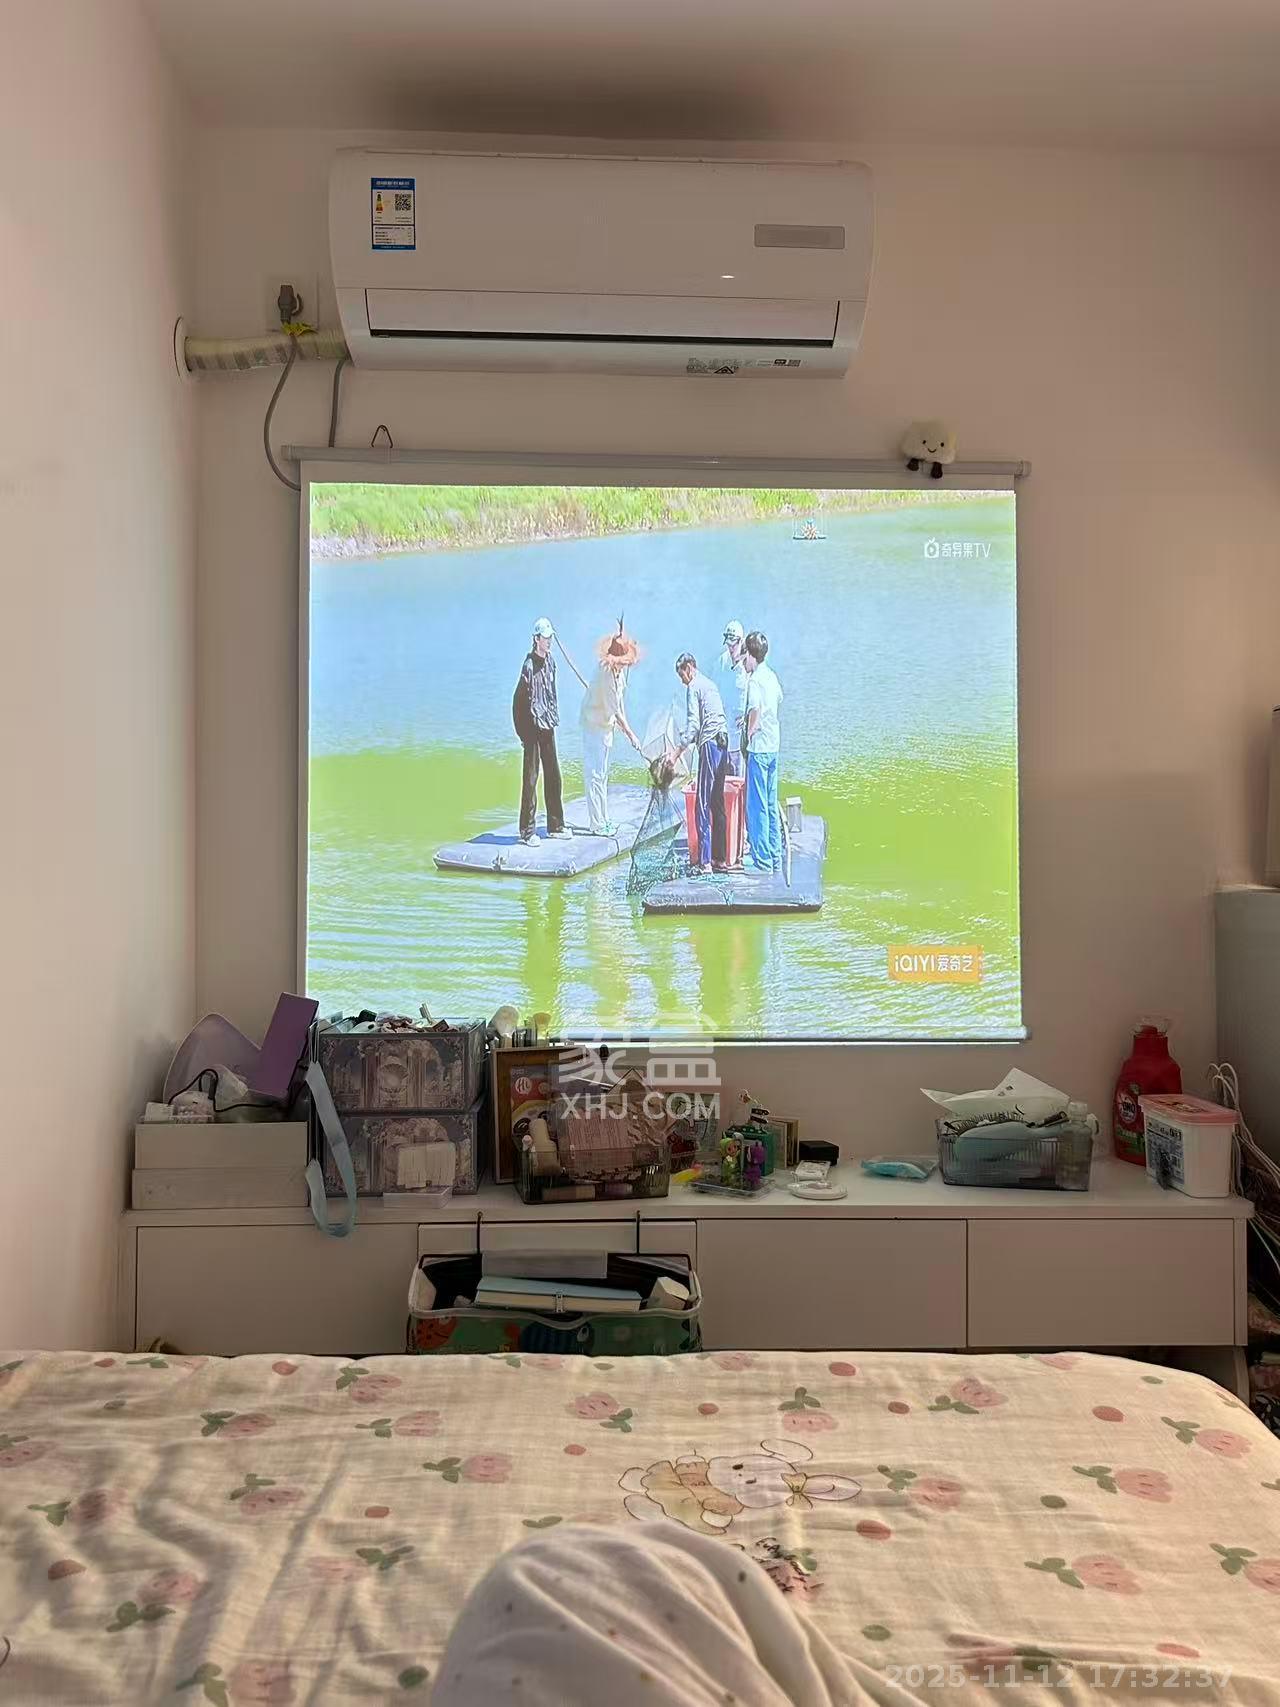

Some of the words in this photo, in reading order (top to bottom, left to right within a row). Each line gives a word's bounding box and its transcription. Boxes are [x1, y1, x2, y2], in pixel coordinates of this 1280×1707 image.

[942, 542, 991, 558] 奇异果TV
[894, 954, 935, 972] iQIYI
[937, 954, 973, 972] 爱奇艺
